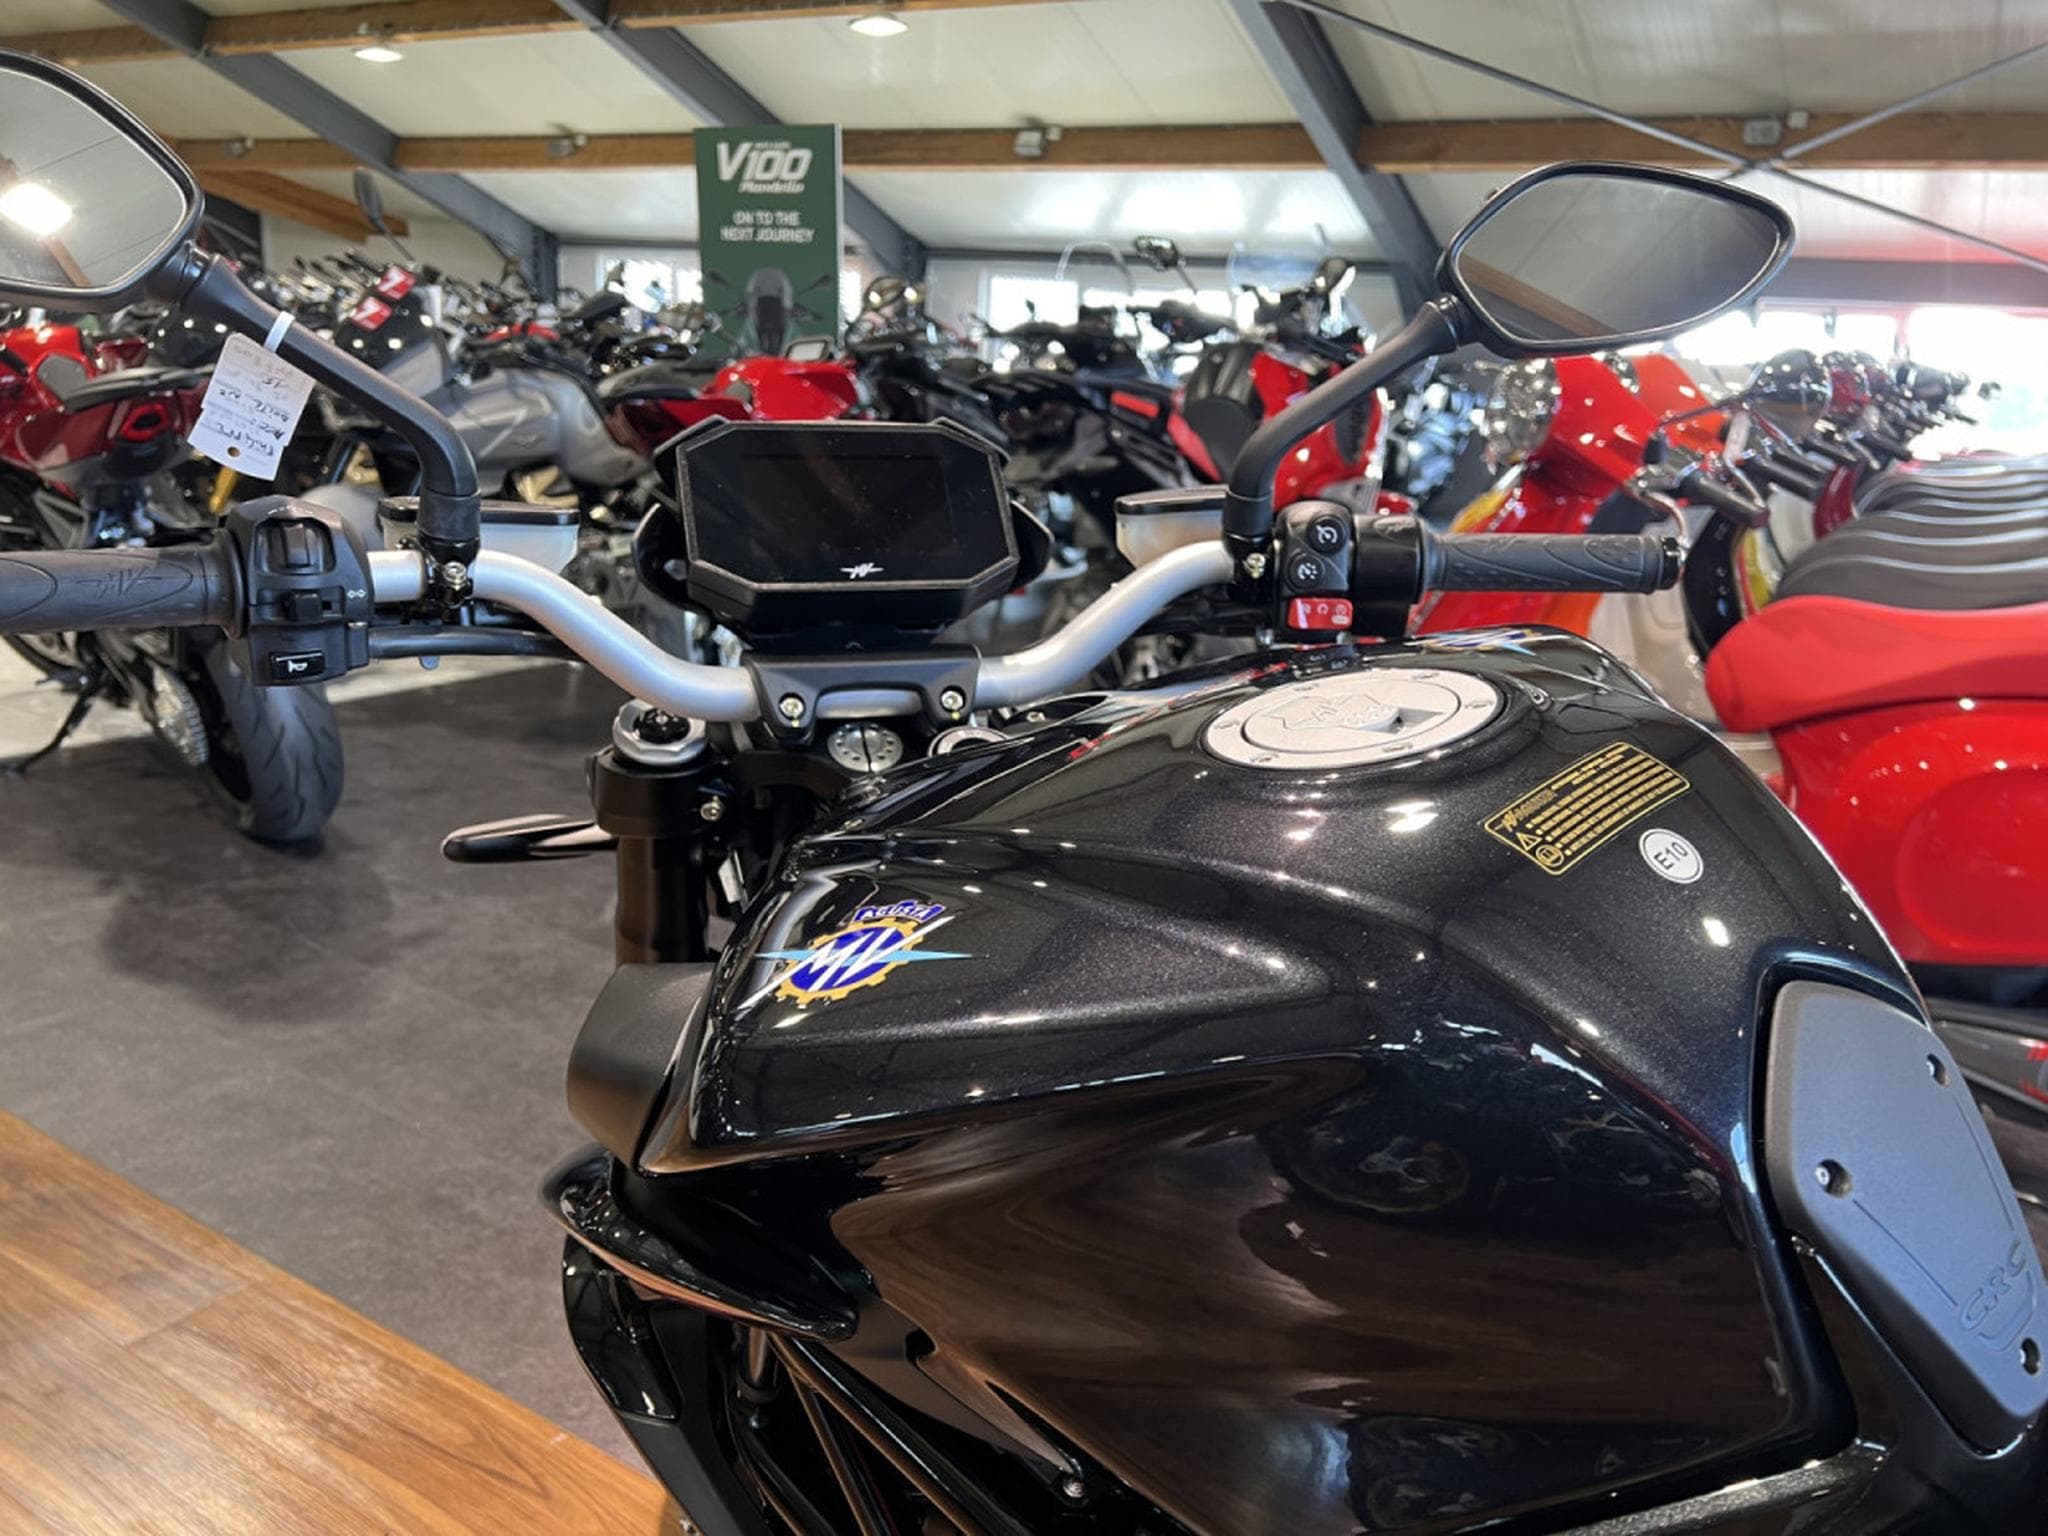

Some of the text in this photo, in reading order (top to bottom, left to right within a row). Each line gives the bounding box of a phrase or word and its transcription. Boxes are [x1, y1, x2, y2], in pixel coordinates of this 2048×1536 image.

[716, 142, 813, 181] V100
[732, 210, 801, 226] ON TO THE
[720, 227, 815, 242] NEXT JOURNEY
[1653, 841, 1689, 871] E10
[856, 901, 938, 921] AGUSTA
